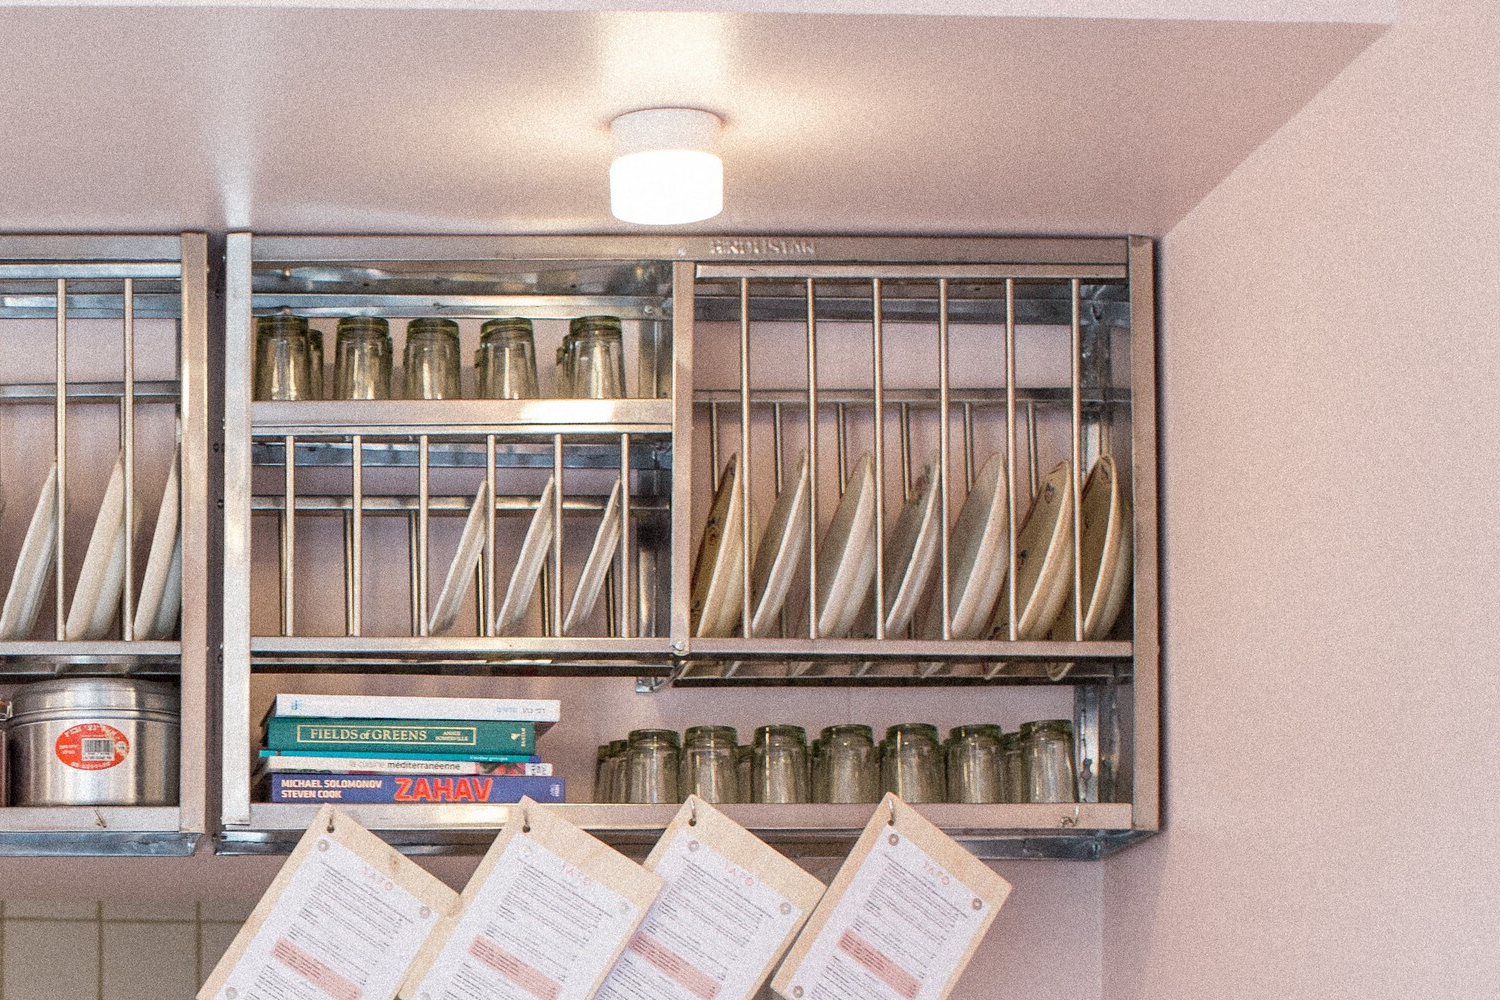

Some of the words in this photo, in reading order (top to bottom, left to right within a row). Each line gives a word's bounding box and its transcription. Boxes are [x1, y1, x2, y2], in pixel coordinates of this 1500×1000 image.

[310, 728, 359, 740] FIELDS
[359, 728, 371, 741] of
[371, 729, 428, 741] GREENS
[387, 760, 461, 770] méditerranéenne
[281, 779, 322, 788] MICHAEL
[324, 780, 382, 789] SOLOMONOV
[281, 790, 316, 798] STEVEN
[317, 790, 342, 799] COOK
[393, 777, 494, 802] ZAHAV
